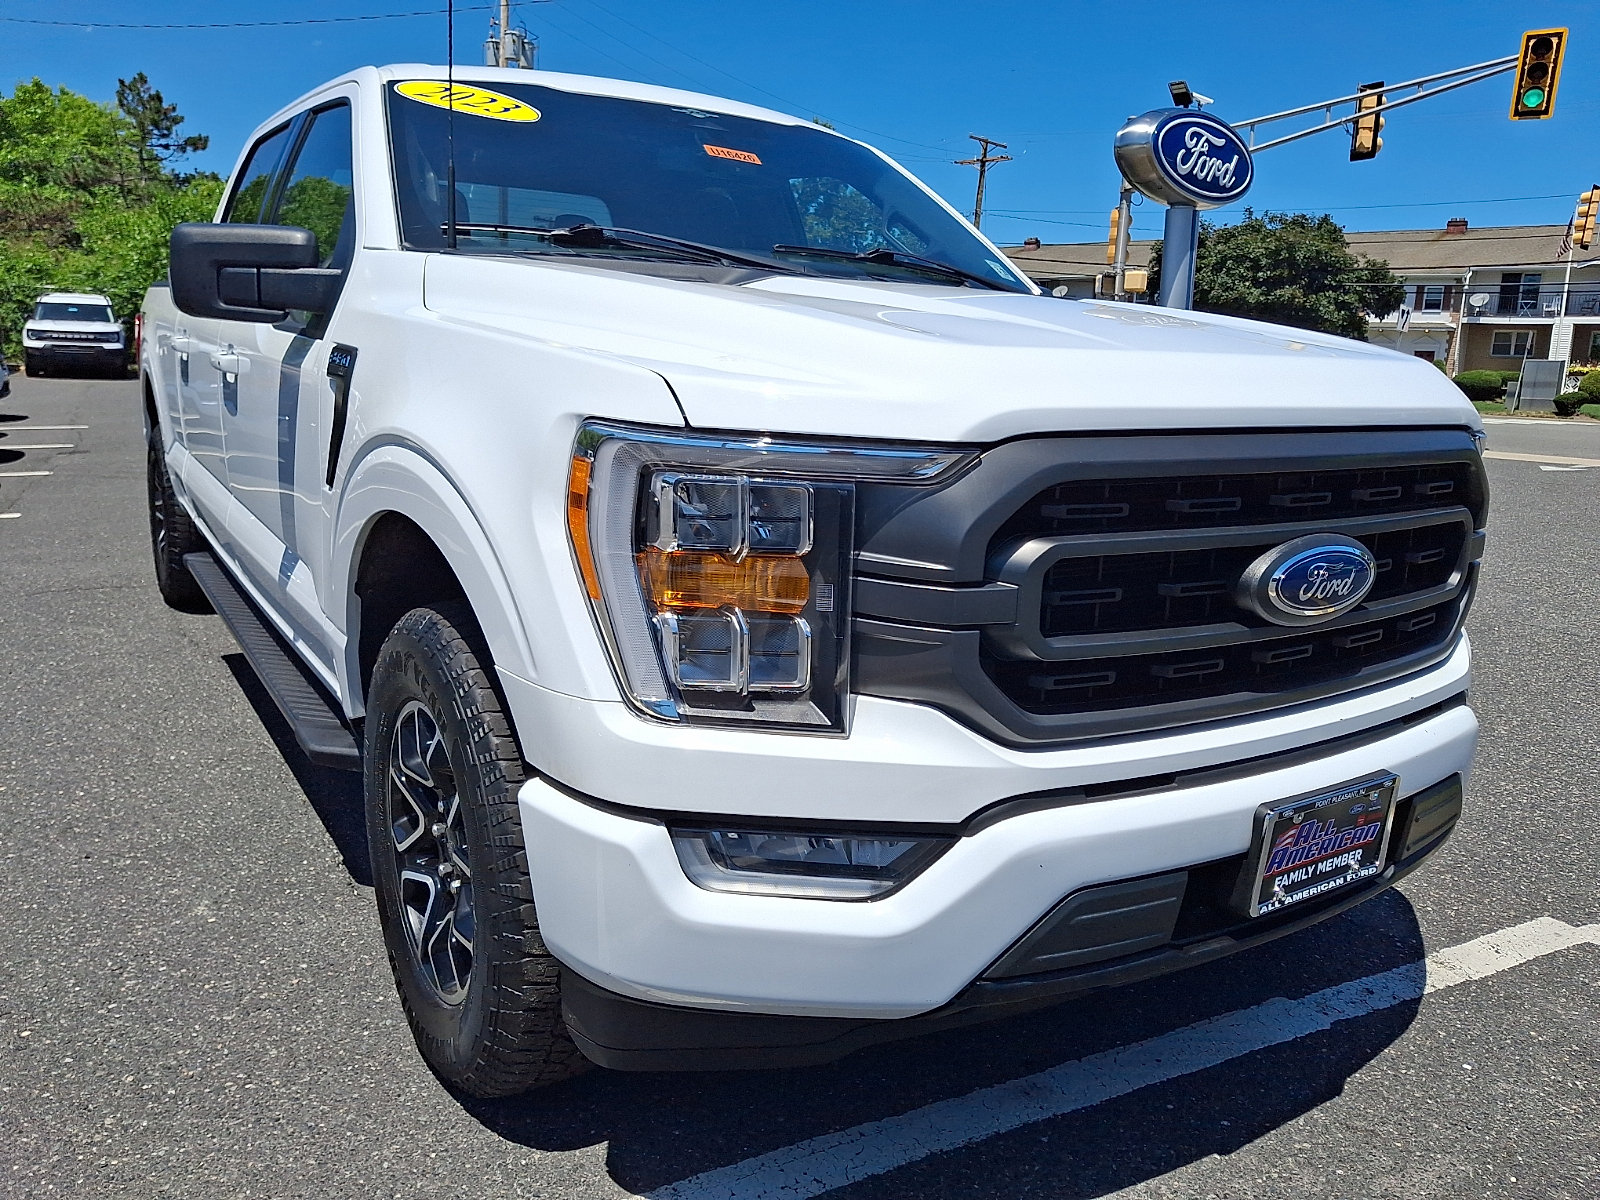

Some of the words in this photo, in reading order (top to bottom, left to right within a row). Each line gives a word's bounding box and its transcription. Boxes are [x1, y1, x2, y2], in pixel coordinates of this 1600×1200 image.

[412, 86, 523, 114] 2023
[1177, 126, 1239, 188] Ford
[1299, 562, 1357, 601] Ford
[1315, 798, 1331, 808] POINT
[1275, 865, 1315, 889] FAMILY
[1317, 849, 1362, 875] MEMBER
[1260, 901, 1281, 915] ALL
[1284, 877, 1344, 905] AMERICAN
[1346, 867, 1377, 883] FORD
